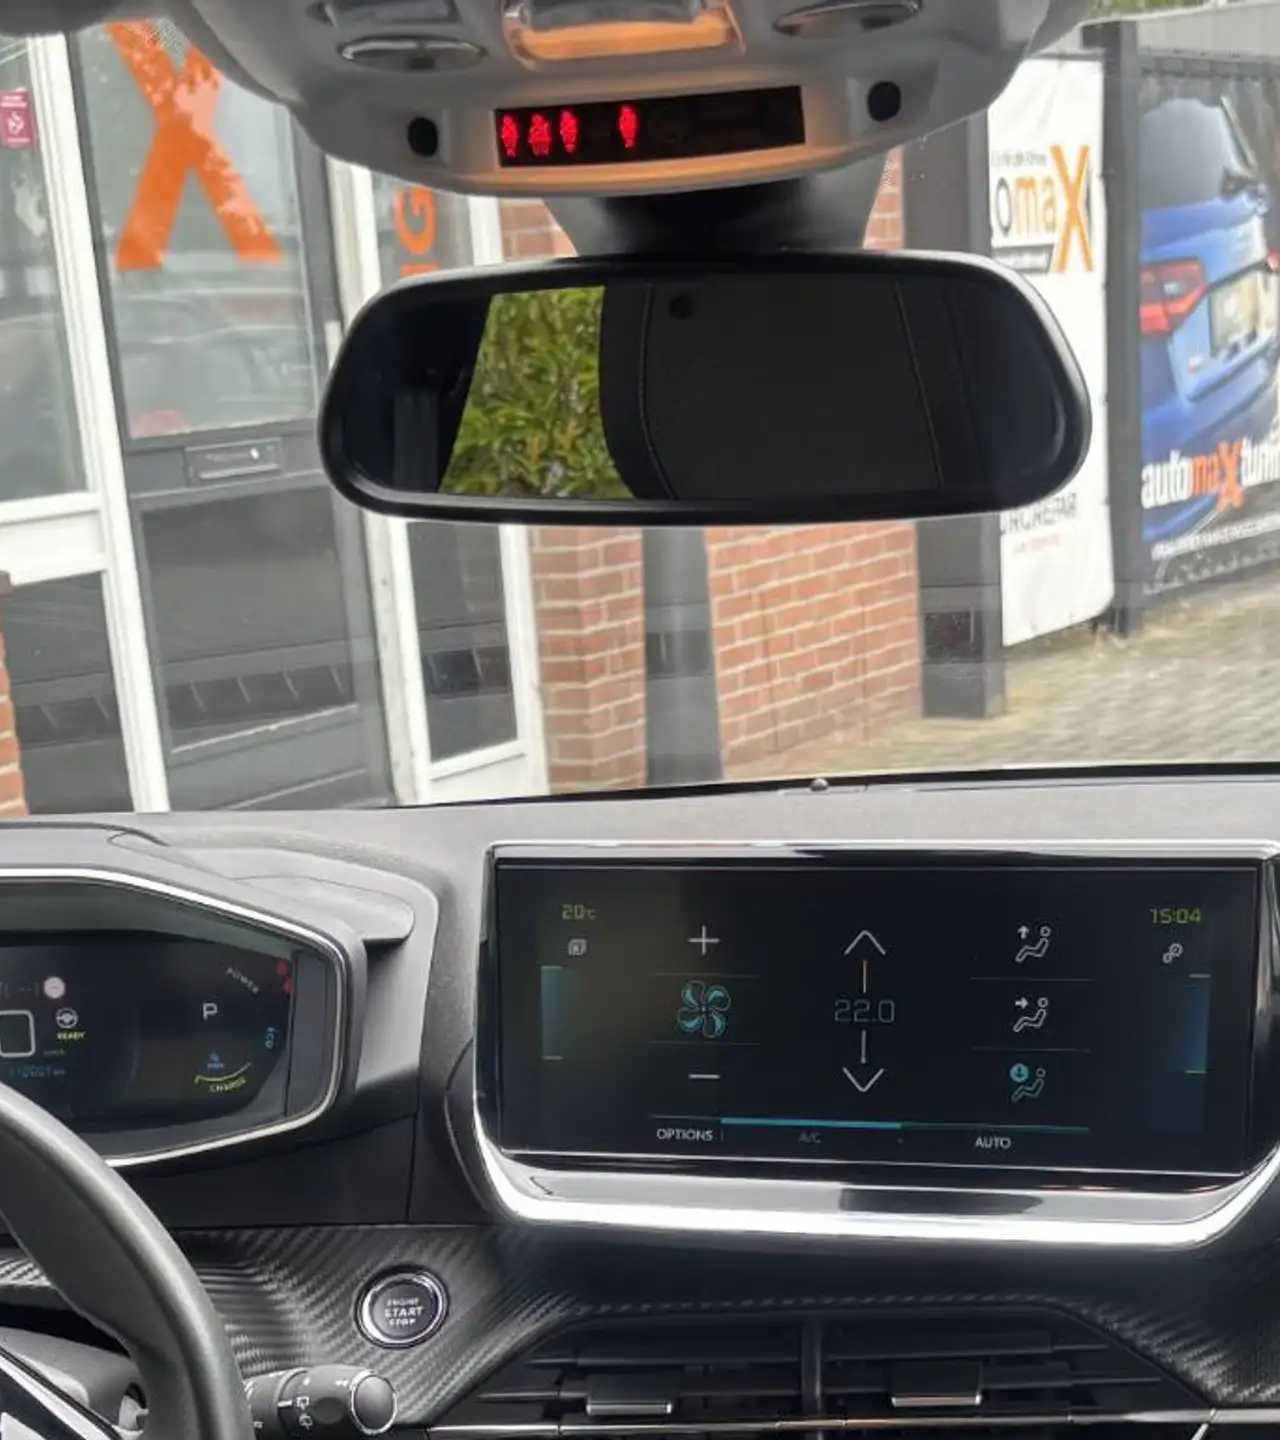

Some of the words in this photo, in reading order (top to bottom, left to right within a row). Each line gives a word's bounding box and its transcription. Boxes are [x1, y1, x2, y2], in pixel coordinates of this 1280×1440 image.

[1149, 906, 1202, 925] 15:04
[201, 1001, 219, 1021] P
[834, 998, 896, 1024] 22.0
[56, 1030, 87, 1041] READY
[655, 1127, 714, 1142] OPTIONS
[799, 1131, 821, 1144] A/C
[973, 1135, 1012, 1150] AUTO
[384, 1306, 423, 1319] START
[388, 1318, 417, 1328] STOP
